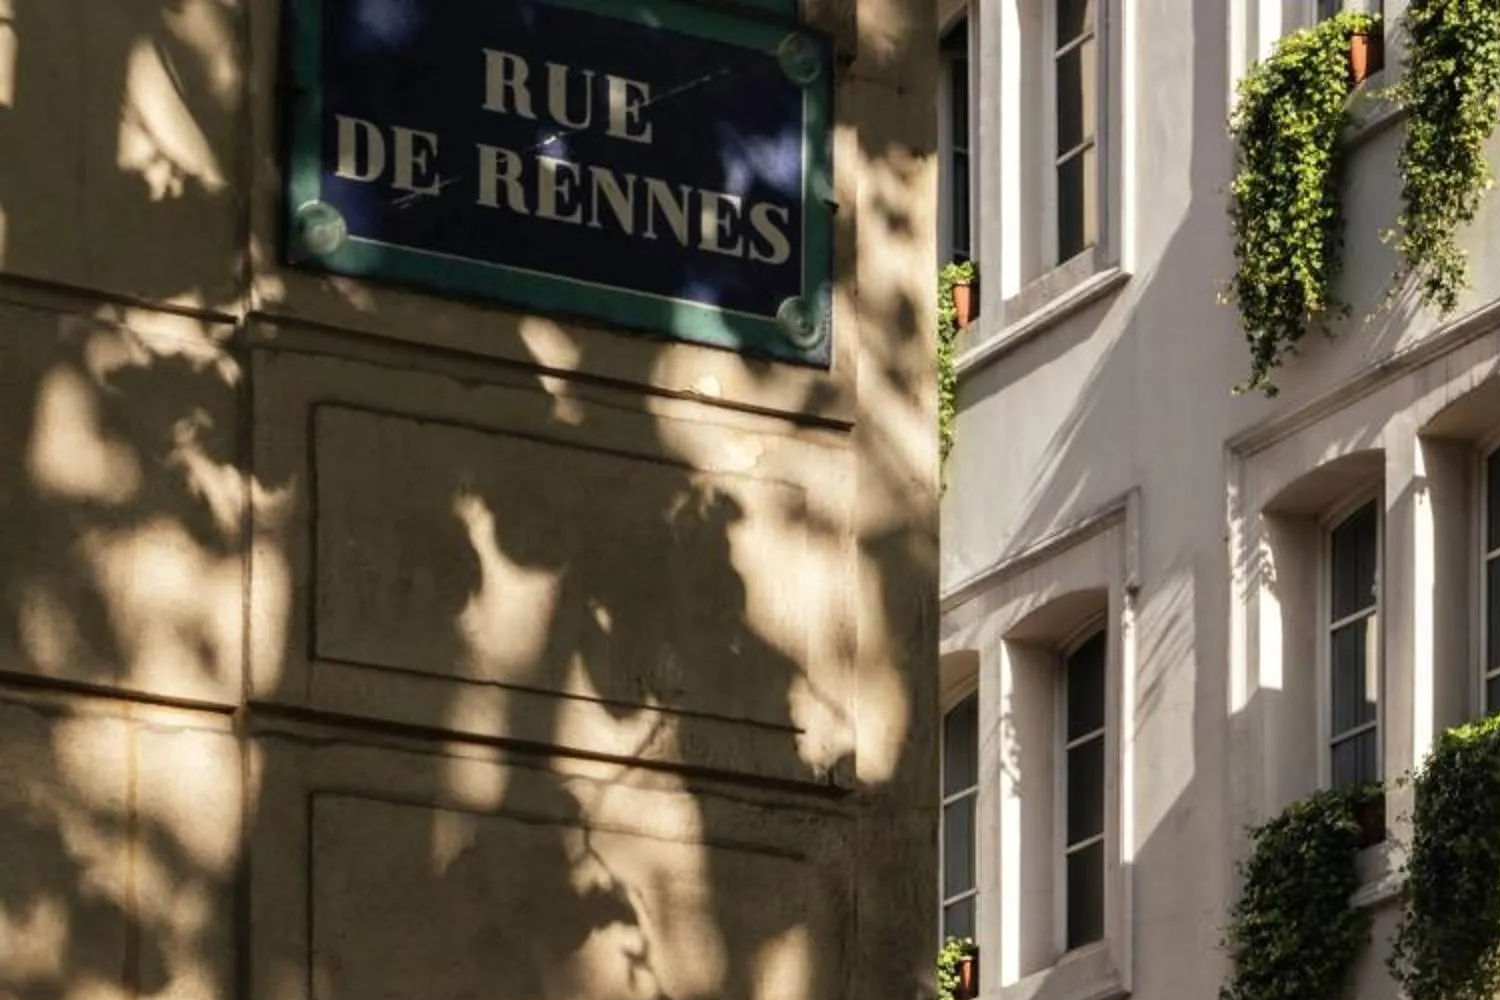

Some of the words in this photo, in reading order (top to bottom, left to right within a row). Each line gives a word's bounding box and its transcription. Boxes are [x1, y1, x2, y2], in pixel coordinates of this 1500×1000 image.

[481, 48, 653, 145] RUE
[334, 114, 440, 196] DE
[476, 143, 791, 266] RENNES
